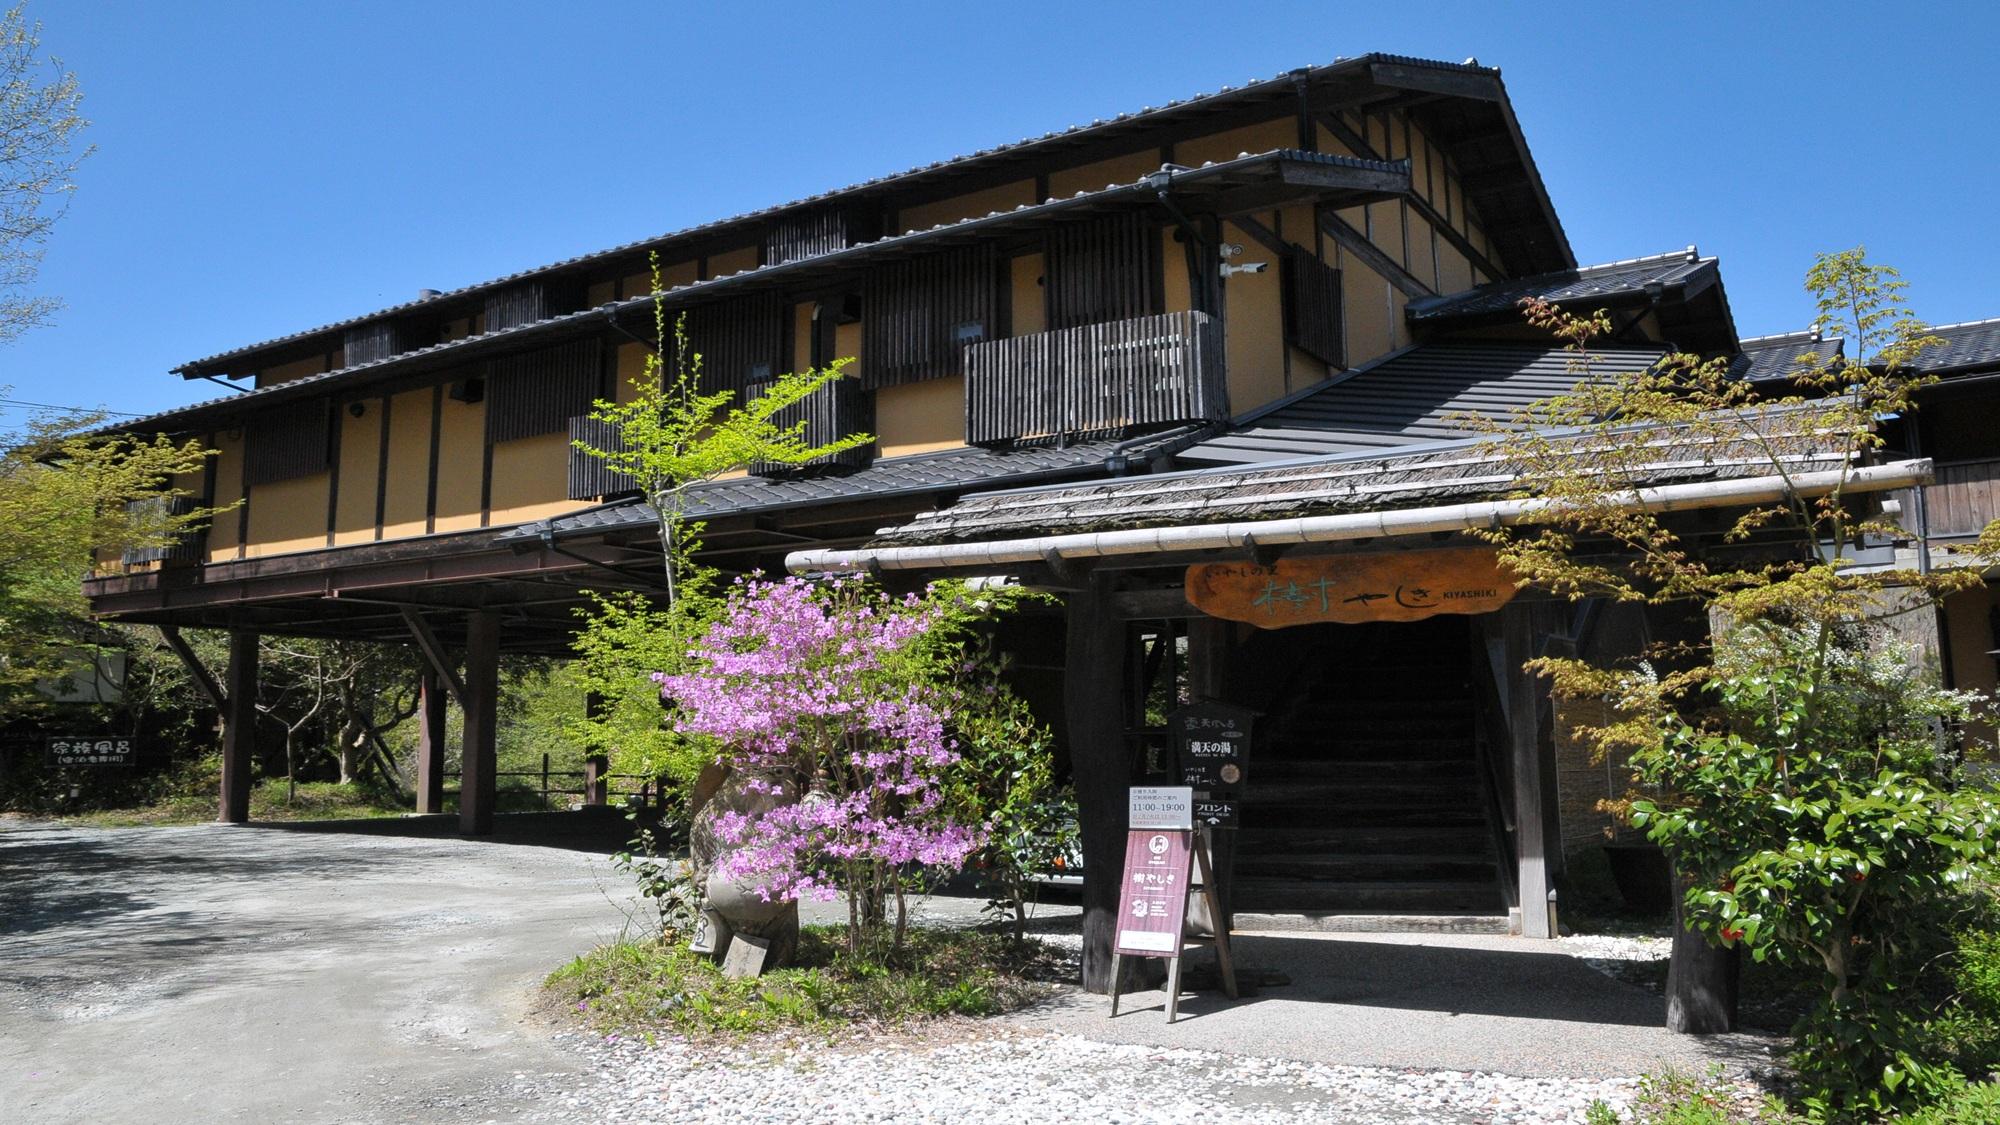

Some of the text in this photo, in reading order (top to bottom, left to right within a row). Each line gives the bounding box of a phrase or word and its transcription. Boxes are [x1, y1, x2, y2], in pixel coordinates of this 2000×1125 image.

[1442, 589, 1497, 600] KIYASHIKI
[52, 740, 130, 754] 家族風呂
[1196, 804, 1232, 812] フロント
[1132, 872, 1175, 885] 樹やしき
